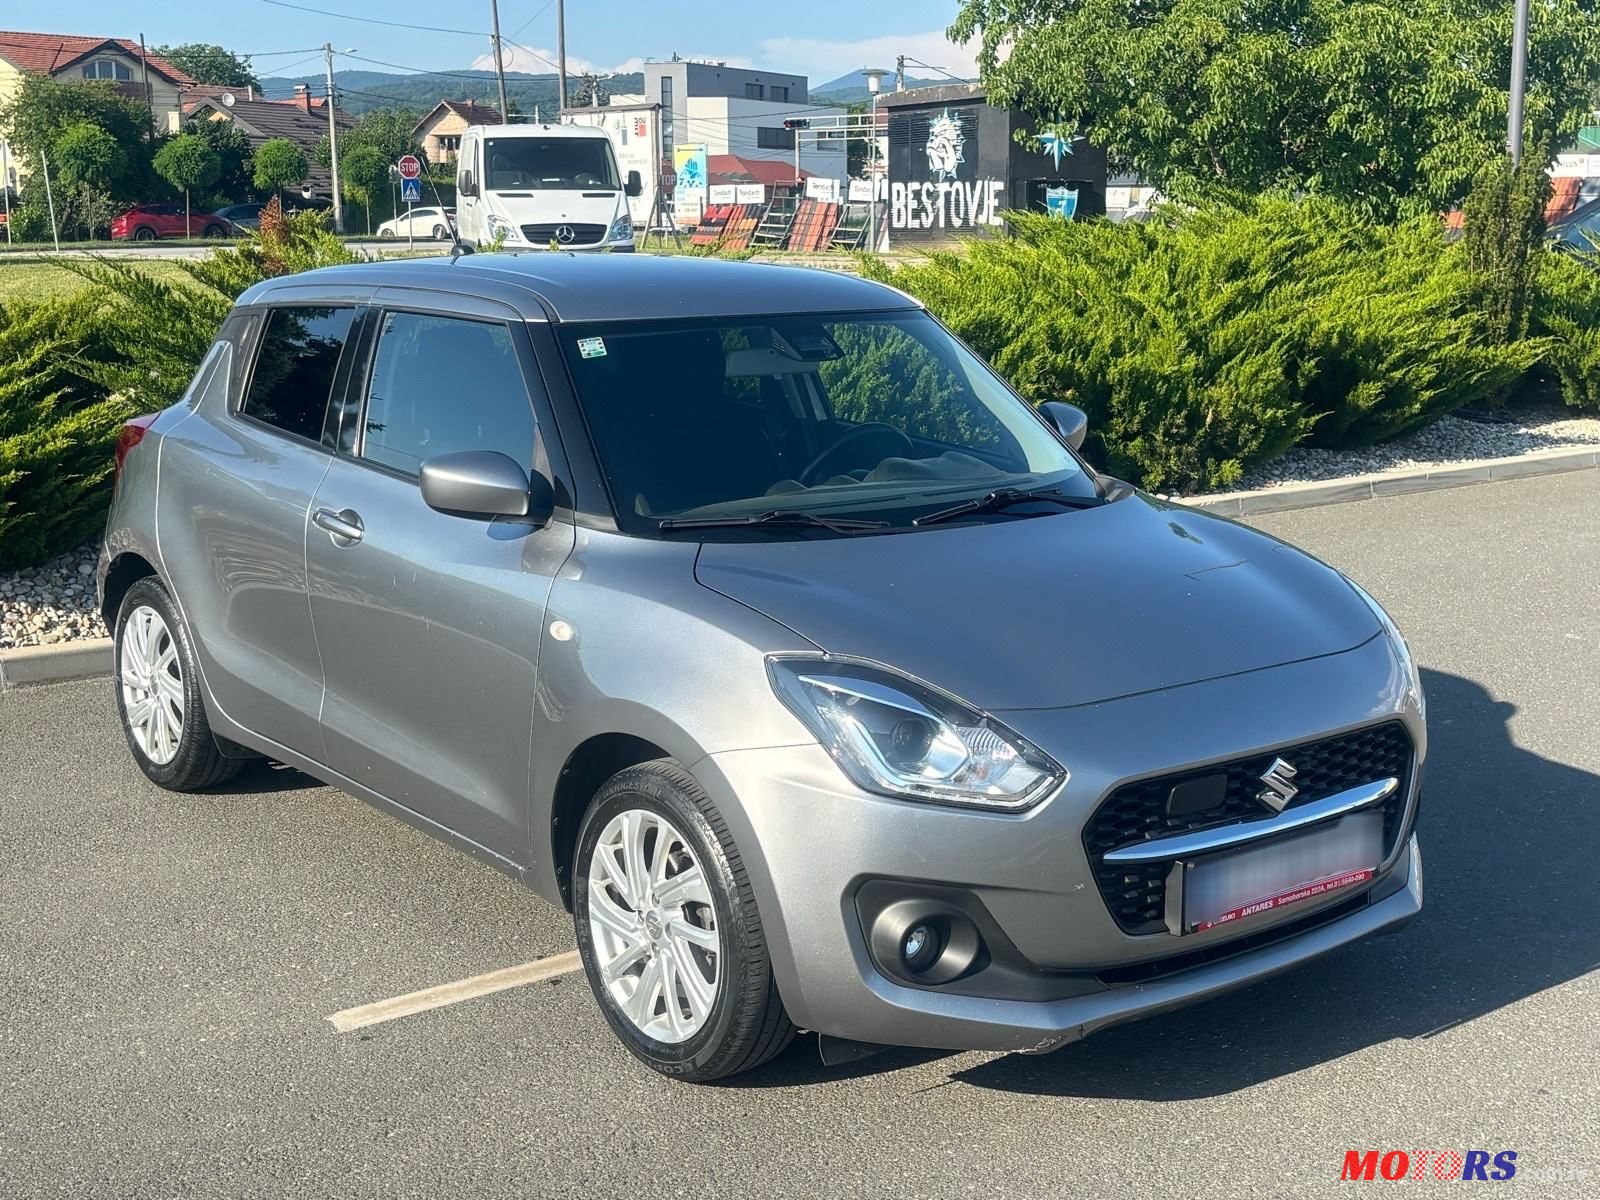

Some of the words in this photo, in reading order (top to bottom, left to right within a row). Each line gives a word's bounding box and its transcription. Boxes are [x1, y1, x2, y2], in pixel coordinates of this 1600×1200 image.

[401, 162, 419, 172] STOP
[661, 174, 676, 186] TOP
[891, 180, 1004, 229] BESTOVJE
[1241, 900, 1274, 917] ANTARES
